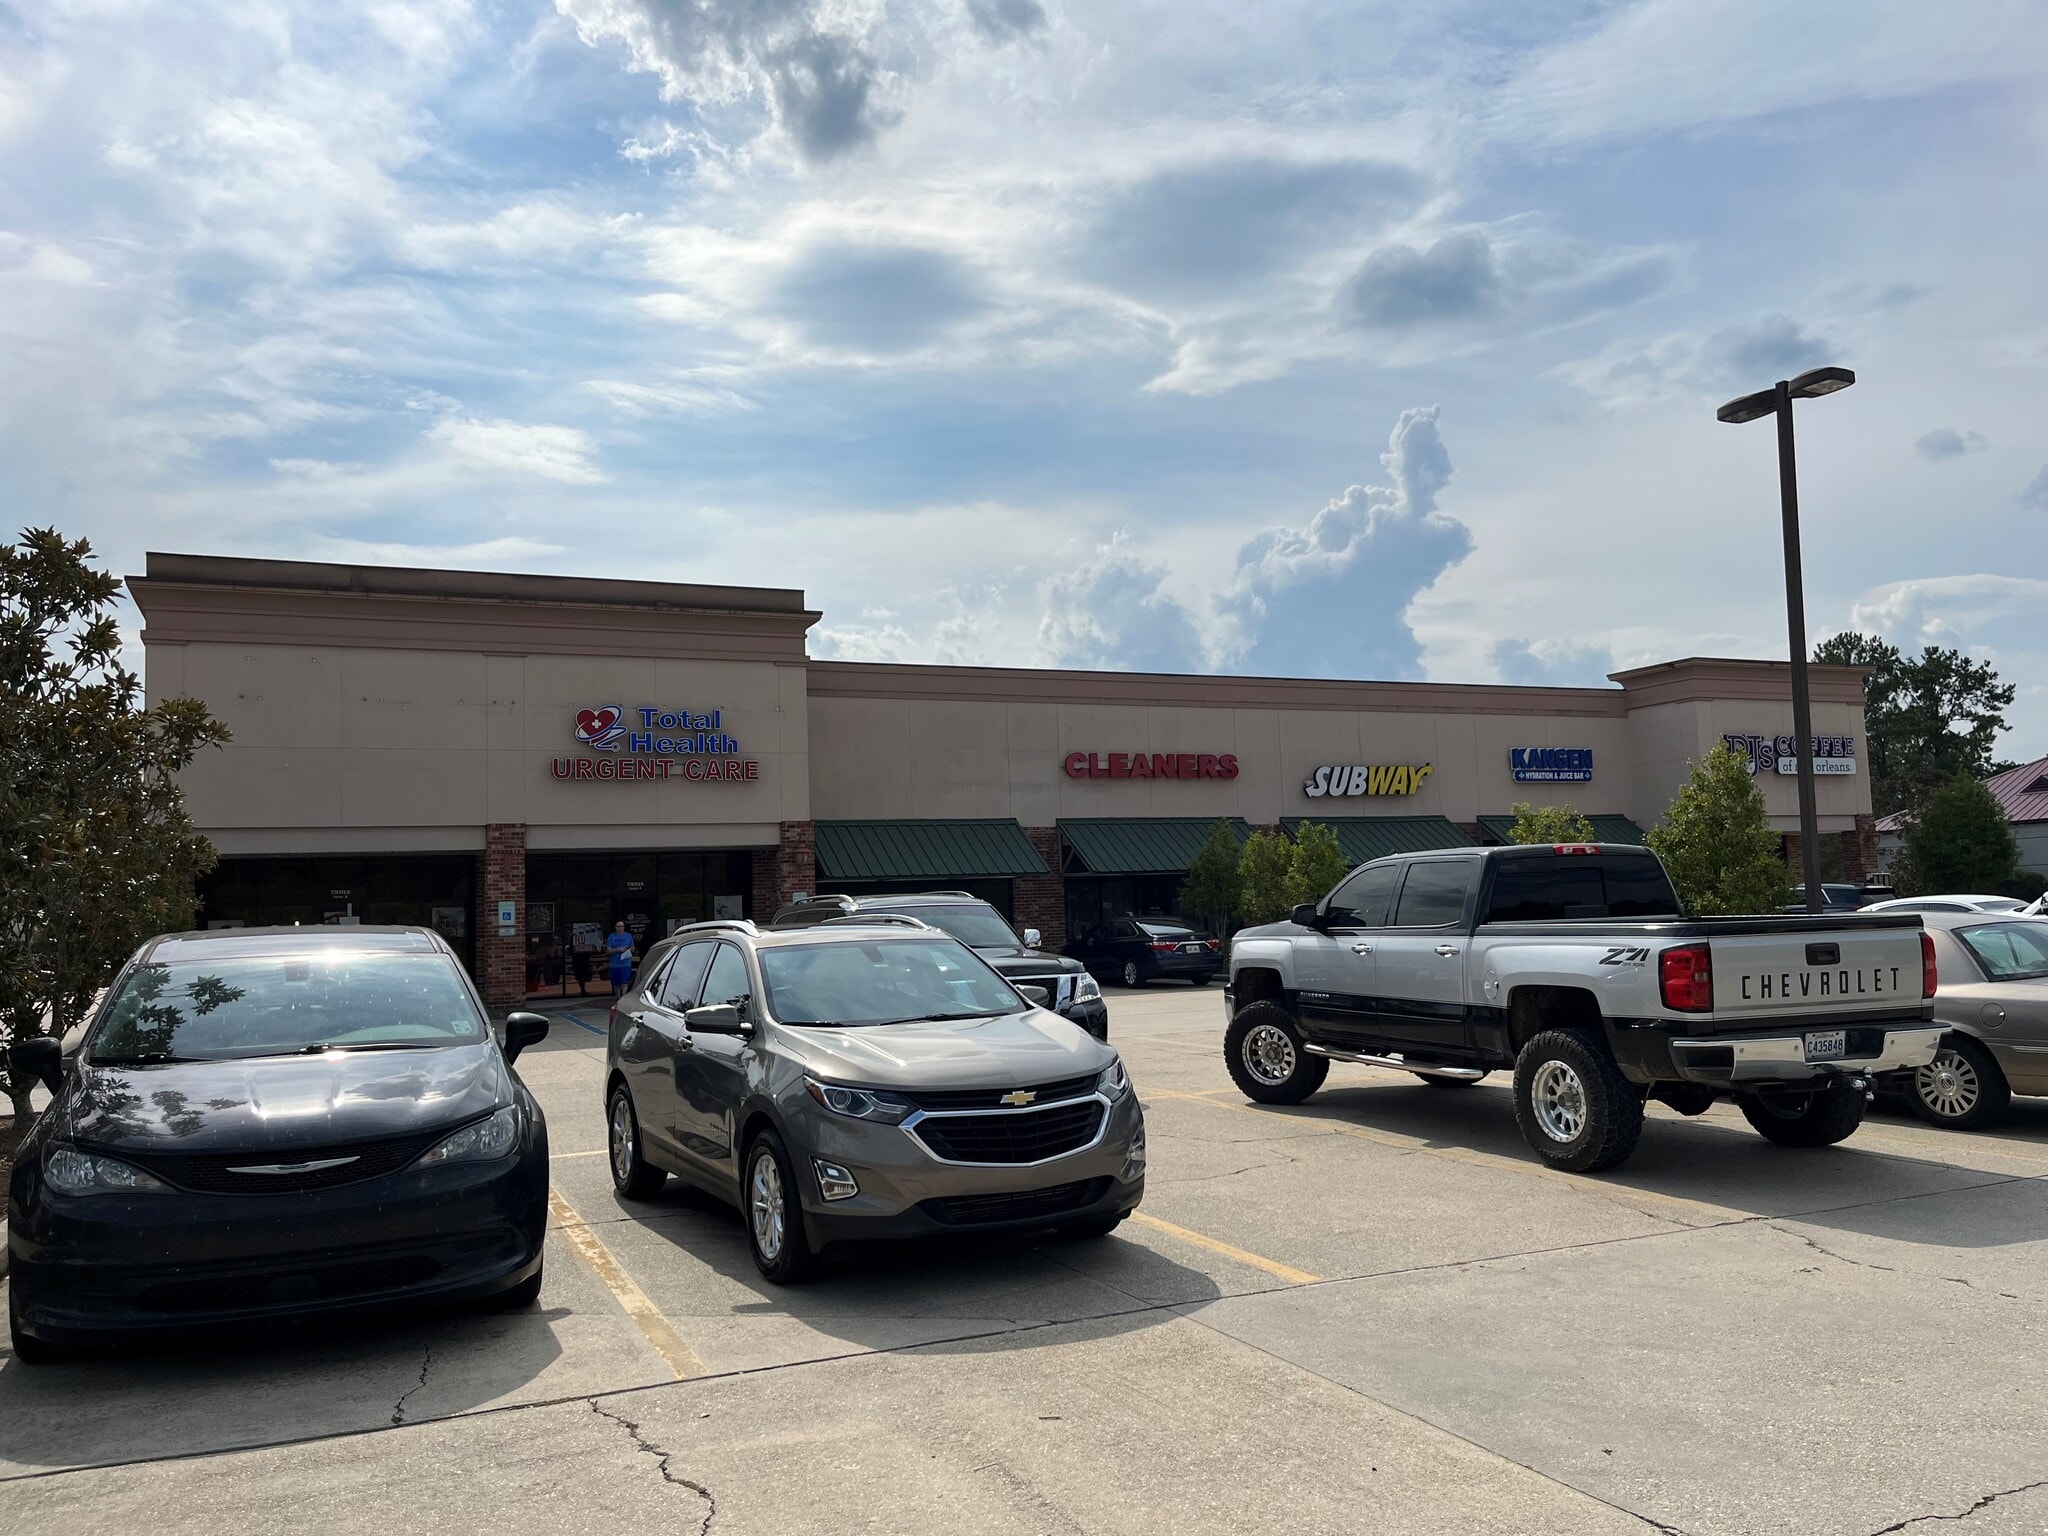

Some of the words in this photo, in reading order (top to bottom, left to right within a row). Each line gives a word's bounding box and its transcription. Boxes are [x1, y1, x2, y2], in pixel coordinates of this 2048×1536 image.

[637, 707, 722, 730] Total
[629, 732, 740, 754] Health
[552, 758, 675, 780] URGENT
[684, 759, 760, 781] CARE
[1064, 752, 1239, 780] CLEANERS
[1510, 748, 1593, 769] KANGEN
[1783, 759, 1793, 772] of
[1815, 759, 1851, 772] orleans
[1304, 762, 1434, 799] SUBWAY
[575, 934, 586, 944] FLU
[1598, 948, 1651, 965] Z71
[1741, 967, 1900, 999] CHEVROLET
[1807, 1039, 1843, 1053] C435848
